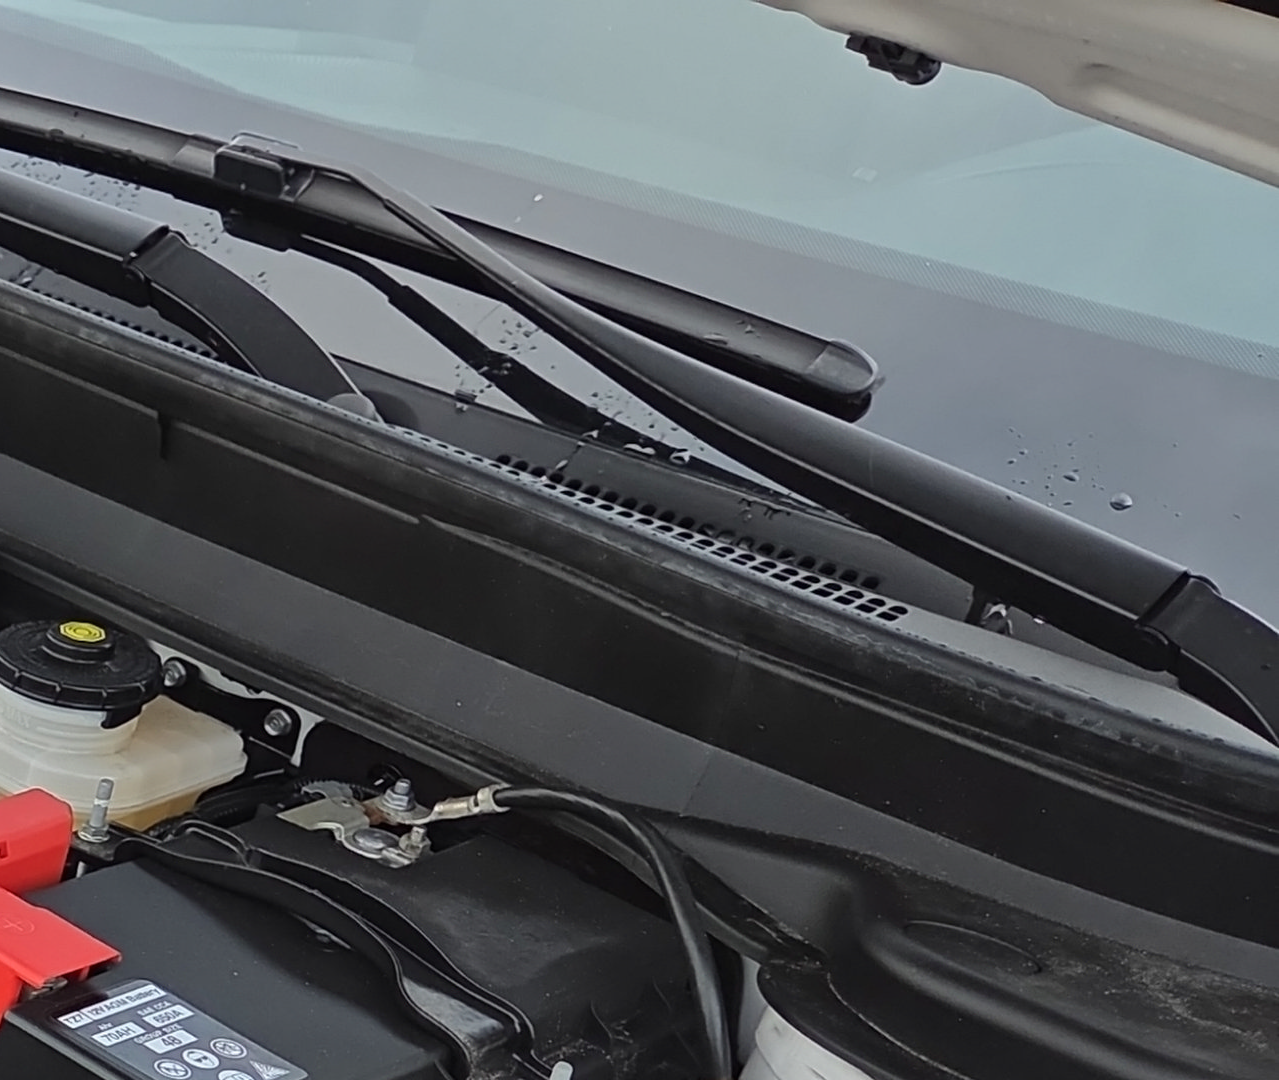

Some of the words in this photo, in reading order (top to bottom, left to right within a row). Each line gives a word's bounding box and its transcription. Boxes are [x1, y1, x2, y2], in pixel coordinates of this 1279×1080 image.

[125, 988, 161, 1002] Battery
[153, 1009, 184, 1023] 650A
[100, 1026, 136, 1042] 70AH
[161, 1035, 183, 1047] 48
